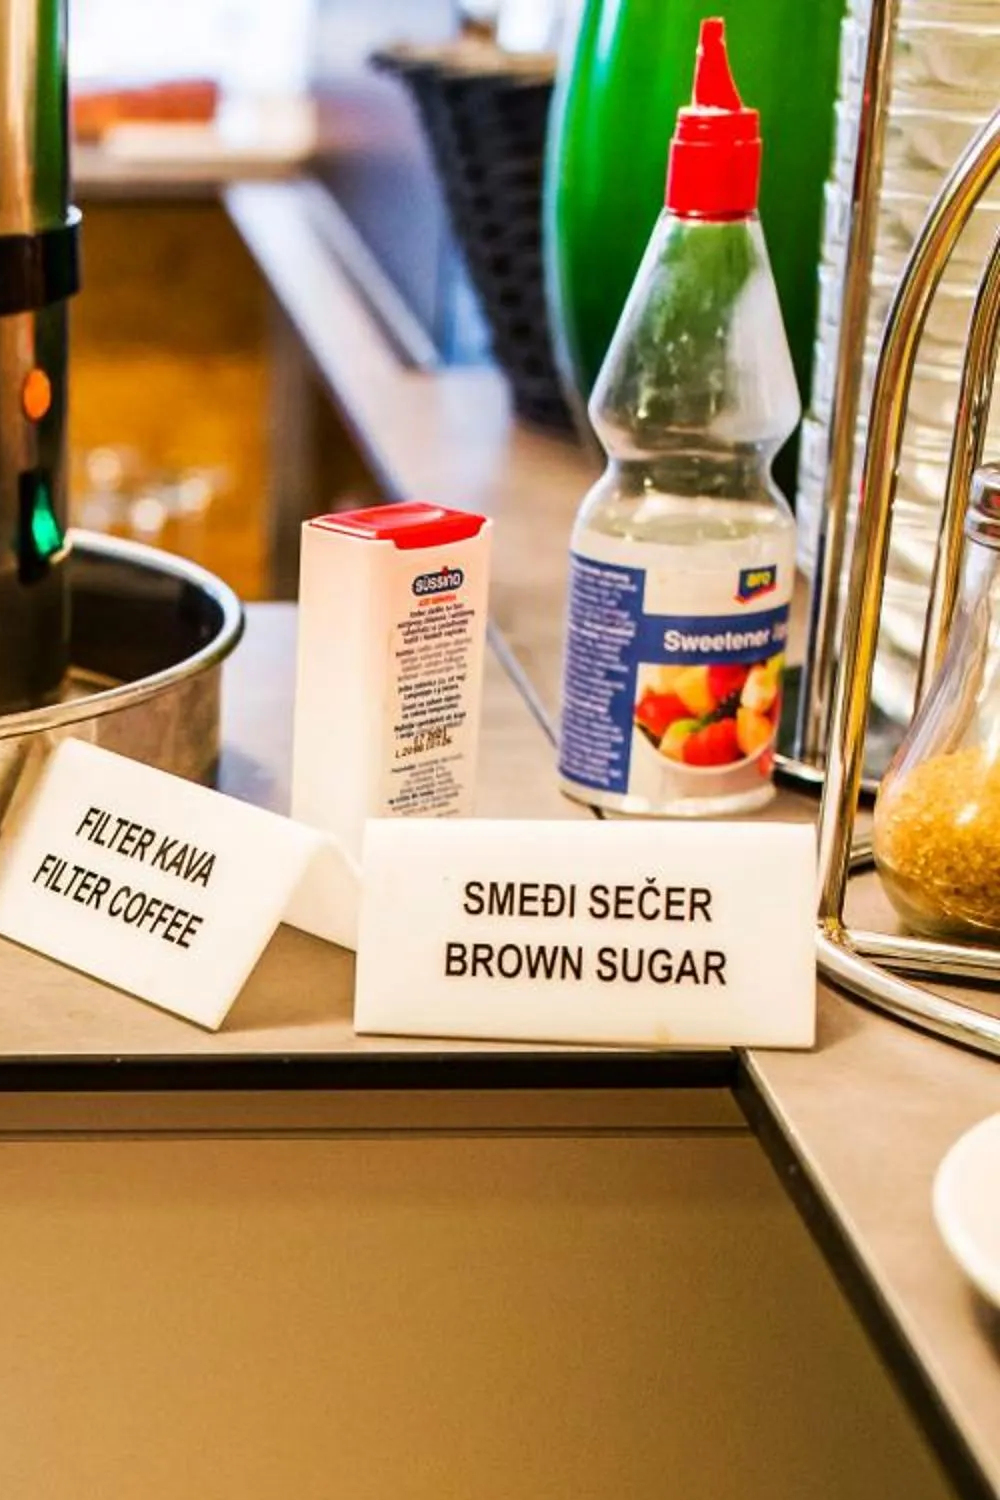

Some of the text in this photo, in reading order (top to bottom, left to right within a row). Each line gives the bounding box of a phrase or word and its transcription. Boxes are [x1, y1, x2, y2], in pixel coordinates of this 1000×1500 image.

[663, 629, 770, 653] Sweetener
[76, 807, 217, 888] FILTER KAVA
[32, 853, 204, 949] FILTER COFFEE
[463, 877, 712, 922] SMEĐI SEČER
[445, 942, 727, 986] BROWN SUGAR
